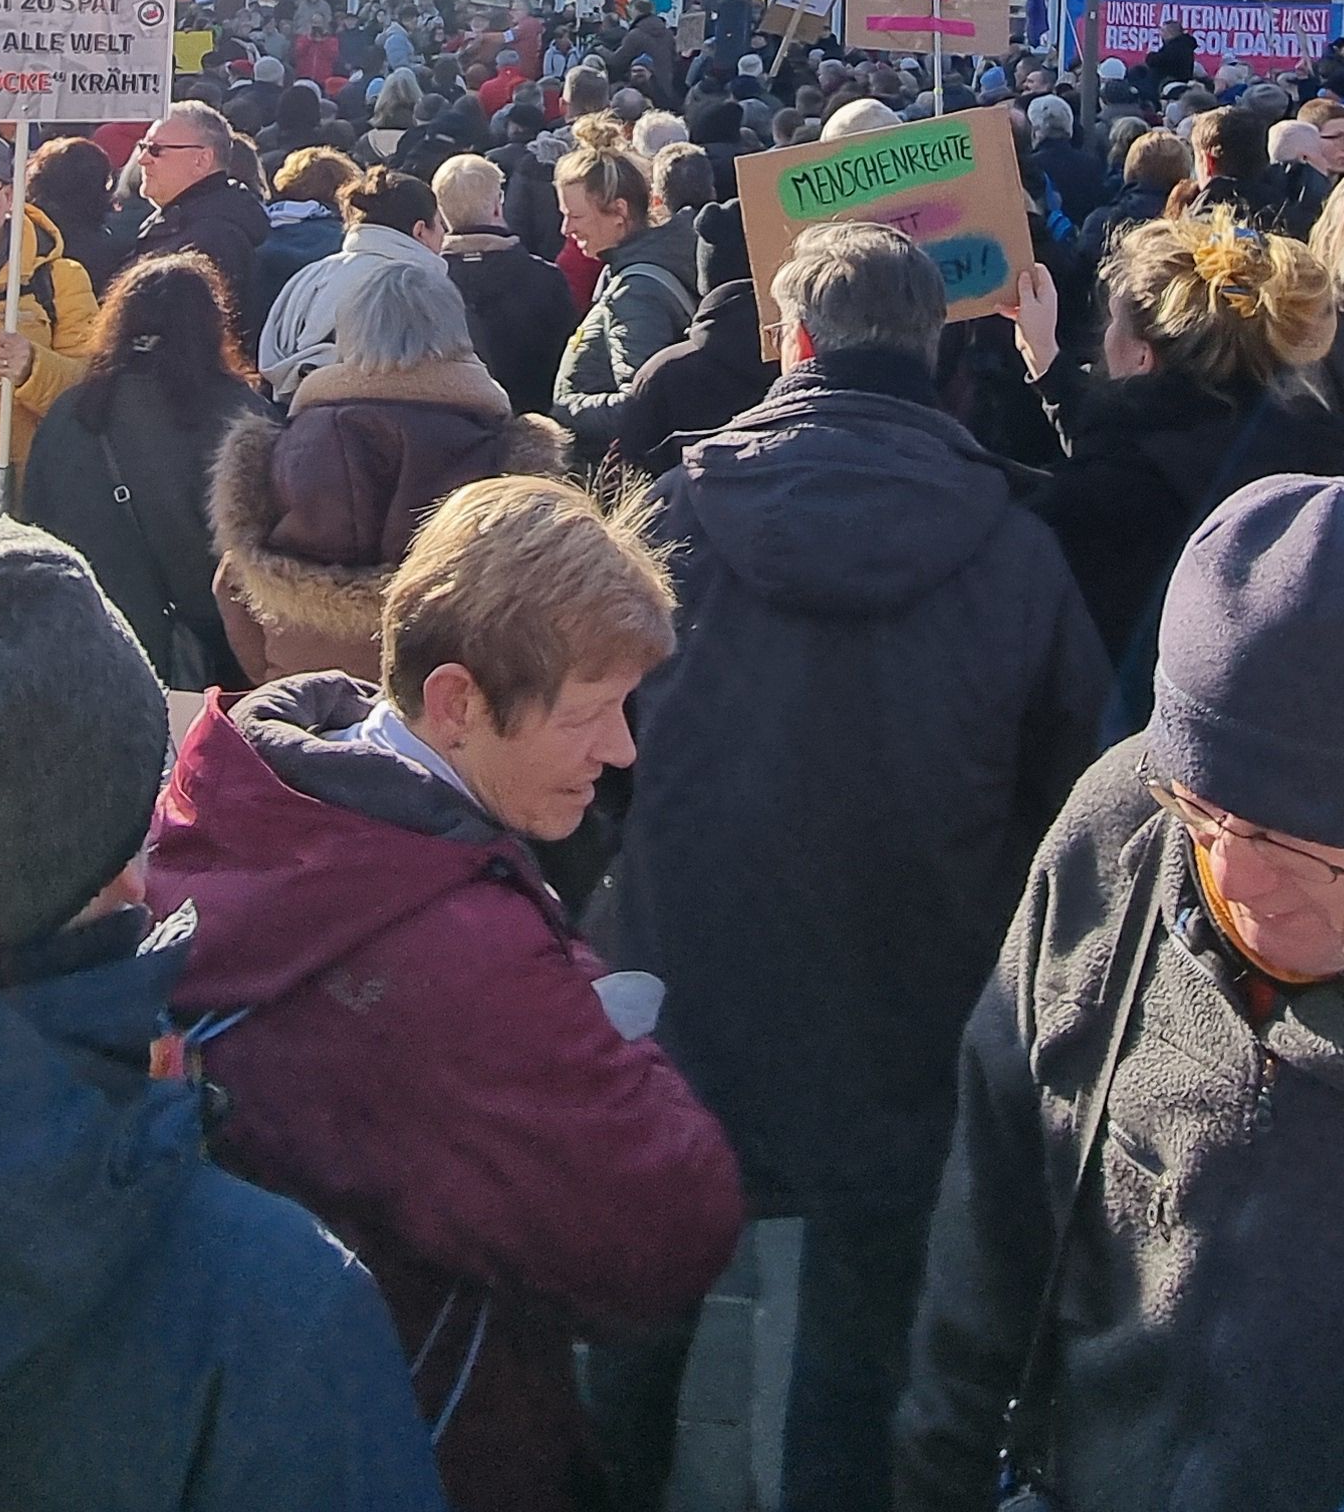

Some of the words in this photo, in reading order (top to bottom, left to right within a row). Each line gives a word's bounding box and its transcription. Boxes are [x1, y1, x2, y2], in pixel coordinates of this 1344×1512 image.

[1106, 0, 1156, 27] UNSERE
[2, 31, 64, 53] ALLE
[70, 33, 135, 55] WELT
[1105, 25, 1164, 54] RESPE
[71, 68, 160, 94] KRÄHT!
[791, 134, 973, 210] MENSCHENRECHTE
